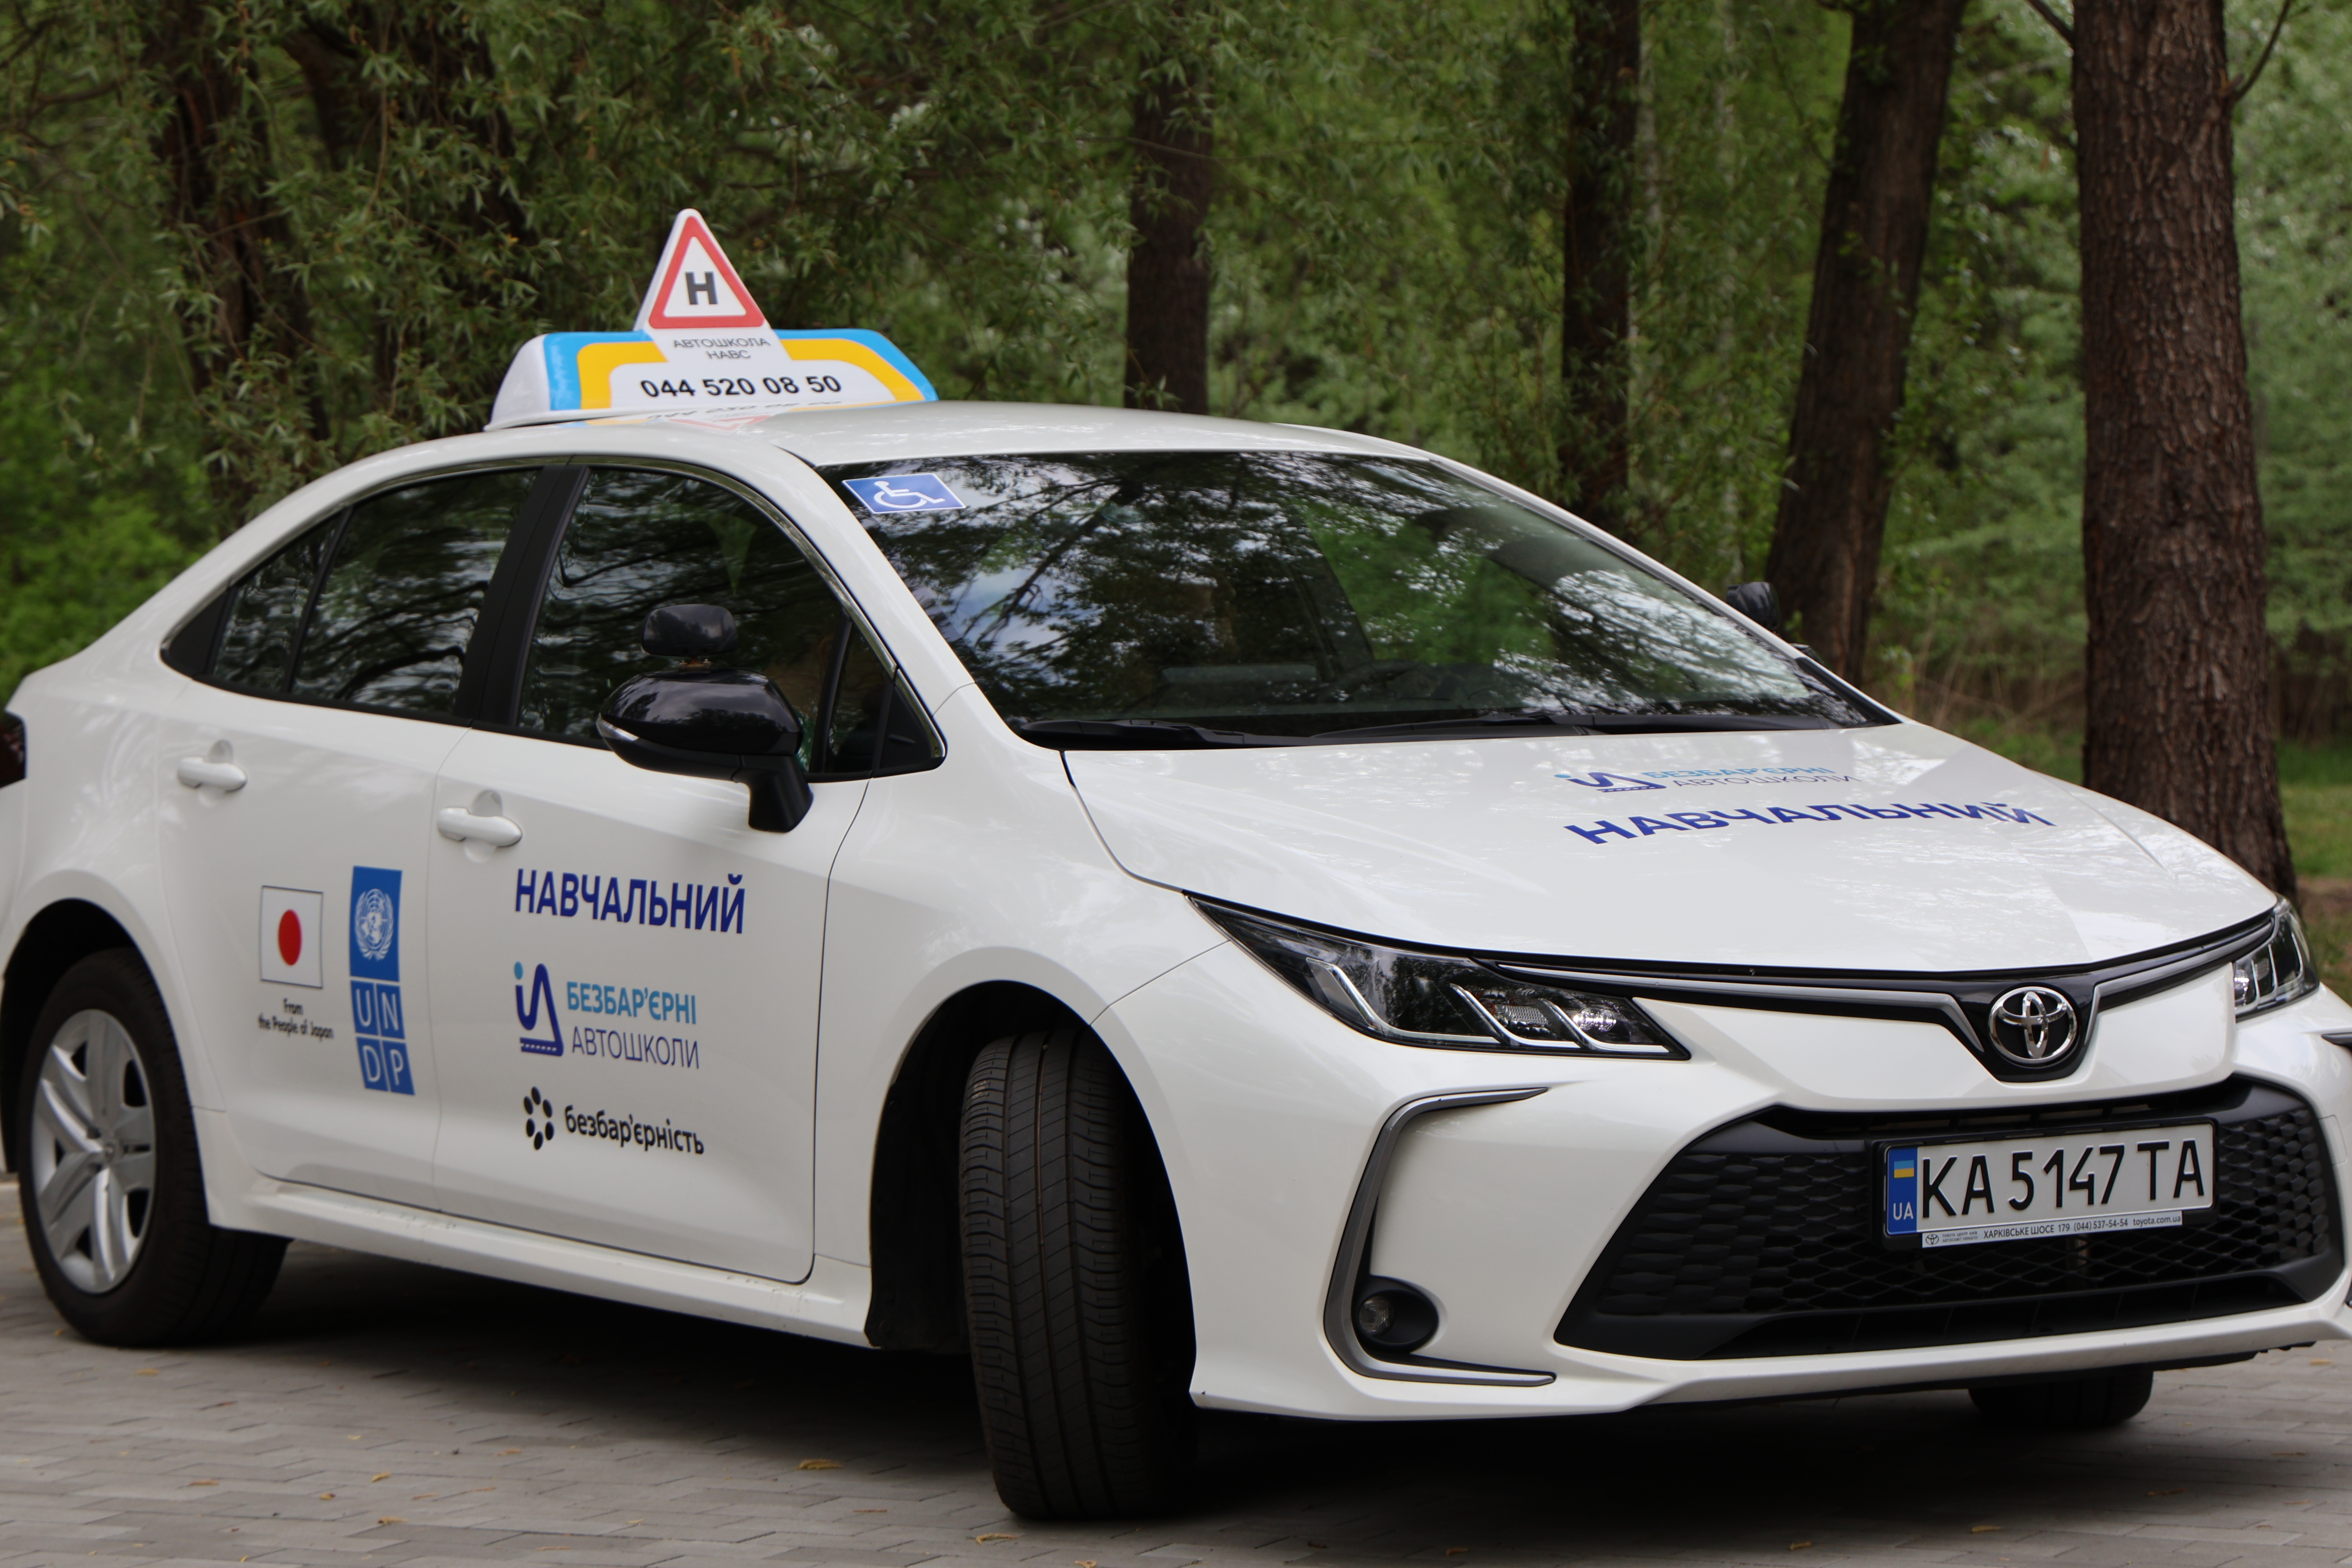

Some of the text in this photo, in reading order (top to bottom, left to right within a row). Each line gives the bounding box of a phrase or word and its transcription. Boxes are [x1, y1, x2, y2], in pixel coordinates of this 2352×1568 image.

[685, 271, 718, 305] Н
[674, 338, 771, 348] АВТОШКОЛА
[706, 349, 751, 359] НАВС
[640, 374, 842, 397] 044 520 08 50
[1641, 767, 1837, 778] БЕЗБАР’ЄРНІ
[1673, 775, 1862, 786] АВТОШКОЛИ
[1563, 801, 2057, 844] НАВЧАЛЬНИЙ
[515, 868, 746, 934] НАВЧАЛЬНИЙ
[283, 998, 303, 1015] From
[356, 988, 399, 1031] UN
[566, 981, 697, 1025] БЕЗБАР’ЄРНІ
[258, 1013, 271, 1030] the
[272, 1015, 298, 1037] People
[310, 1021, 334, 1042] Japan
[572, 1026, 699, 1069] АВТОШКОЛИ
[363, 1045, 404, 1086] DP
[565, 1105, 704, 1155] безбар’єрність
[1922, 1139, 2204, 1218] KA 5147 TA
[1893, 1202, 1914, 1221] UA
[1984, 1215, 2181, 1238] ХАРКІВСЬКЕ ШОСЕ 179 (044) 537-54-54 toyota.com.ua
